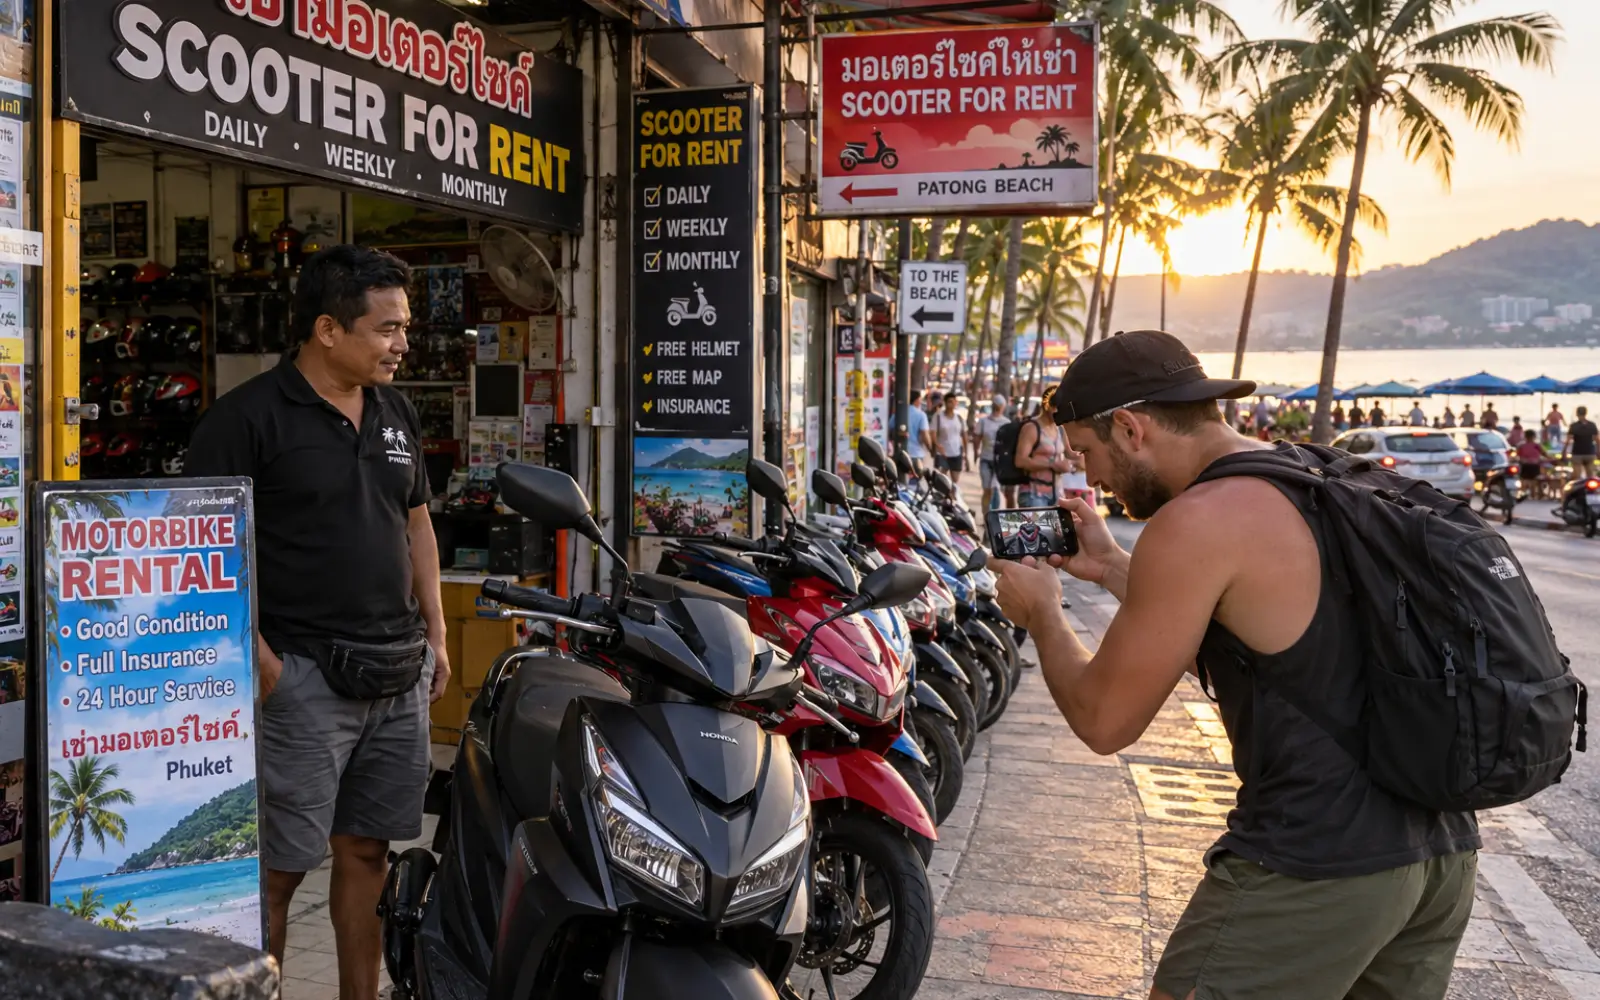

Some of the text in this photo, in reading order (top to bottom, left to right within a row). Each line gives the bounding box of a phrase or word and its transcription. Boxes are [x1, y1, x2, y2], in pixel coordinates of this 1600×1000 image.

[841, 36, 1077, 83] มอเตอร์ไซค์ให้เช่า
[115, 3, 571, 194] SCOOTER FOR RENT
[841, 84, 1077, 118] SCOOTER FOR RENT
[640, 105, 743, 137] SCOOTER
[204, 110, 508, 208] DAILY WEEKLY MONTHLY
[640, 138, 742, 169] FOR RENT
[666, 185, 711, 205] DAILY
[917, 177, 1054, 196] PATONG BEACH
[666, 217, 728, 238] WEEKLY
[666, 250, 740, 271] MONTHLY
[909, 269, 959, 283] TO THE
[909, 286, 957, 301] BEACH
[657, 341, 740, 356] FREE HELMET
[657, 370, 722, 385] FREE MAP
[657, 399, 731, 415] INSURANCE
[60, 514, 236, 552] MOTORBIKE
[60, 552, 237, 601] RENTAL
[76, 610, 228, 641] Good Condition
[77, 647, 217, 676] Full Insurance
[77, 676, 236, 712] 24 Hour Service
[166, 755, 233, 781] Phuket
